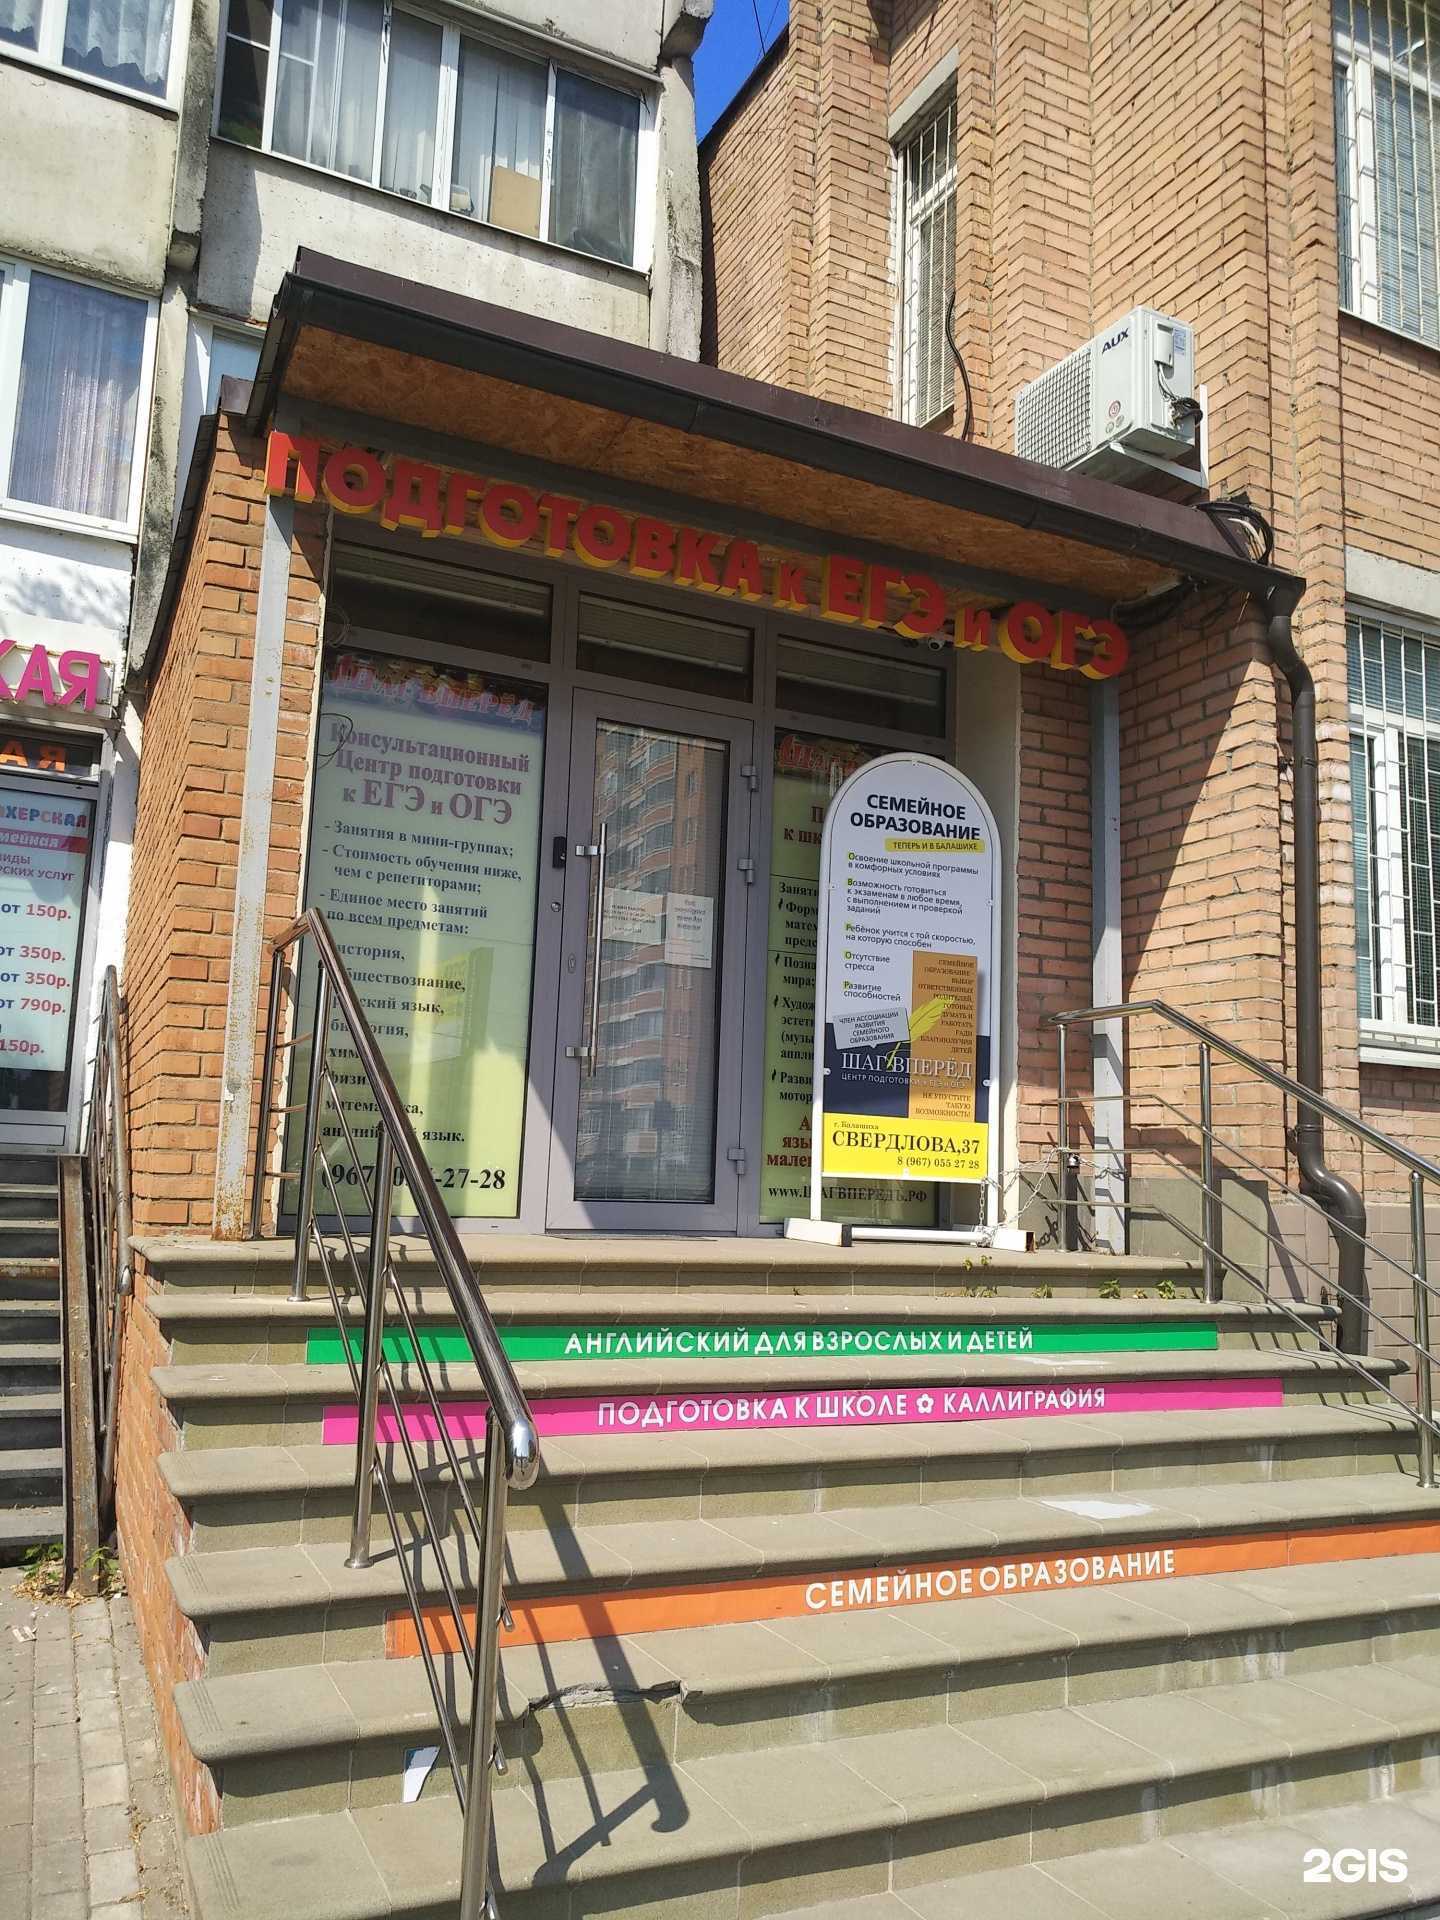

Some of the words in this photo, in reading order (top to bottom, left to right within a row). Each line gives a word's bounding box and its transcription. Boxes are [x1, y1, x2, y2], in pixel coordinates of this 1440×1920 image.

[1102, 327, 1129, 355] AUX
[264, 430, 763, 600] ПОДГОТОВКА
[820, 554, 946, 639] ЕГЭ
[1000, 602, 1129, 680] ОГЭ
[330, 723, 530, 772] Консультационный
[336, 749, 402, 780] Центр
[408, 764, 522, 795] подготовки
[361, 779, 425, 812] ЕГЭ
[431, 800, 443, 815] и
[450, 793, 512, 825] ОГЭ
[866, 794, 966, 820] СЕМЕЙНОЕ
[850, 812, 980, 840] ОБРАЗОВАНИЕ
[334, 820, 394, 840] Занятия
[399, 832, 407, 842] в
[411, 834, 514, 857] мини-группах;
[893, 841, 920, 850] ТЕПЕРЬ
[922, 842, 928, 850] И
[936, 842, 978, 850] БАЛАШИХЕ
[0, 853, 31, 864] ИДЫ
[332, 843, 412, 866] Стоимость
[415, 856, 479, 876] обучения
[484, 867, 522, 881] ниже,
[848, 852, 889, 864] Освоение
[890, 857, 930, 870] школьной
[933, 864, 979, 876] программы
[334, 866, 361, 879] чем
[366, 870, 373, 880] с
[376, 872, 481, 894] репетиторами;
[905, 868, 940, 879] условиях
[847, 878, 902, 892] Возможность
[904, 886, 947, 897] готовиться
[854, 888, 898, 900] экзаменам
[907, 895, 933, 904] любое
[26, 903, 71, 921] 150р.
[330, 888, 382, 907] Единое
[387, 896, 427, 912] место
[431, 901, 488, 918] занятий
[847, 904, 881, 915] заданий
[853, 898, 909, 909] выполнением
[918, 903, 963, 916] проверкой
[327, 909, 344, 922] по
[349, 913, 382, 926] всем
[387, 915, 469, 935] предметам:
[857, 935, 892, 946] которую
[894, 939, 932, 949] способен
[881, 929, 908, 939] учится
[916, 930, 930, 941] той
[20, 945, 66, 963] 350р.
[845, 951, 890, 963] Отсутствие
[844, 962, 875, 972] стресса
[25, 972, 70, 990] 350р.
[844, 981, 882, 992] Развитие
[844, 990, 901, 1001] способностей
[20, 998, 66, 1016] 790р.
[401, 1002, 444, 1014] язык,
[839, 1016, 856, 1024] ЧЛЕН
[856, 1011, 899, 1022] АССОЦИАЦИИ
[855, 1020, 886, 1029] РАЗВИТИЯ
[850, 1033, 894, 1043] ОБРАЗОВАНИЯ
[852, 1026, 890, 1037] СЕМЕЙНОГО
[841, 1052, 886, 1071] ШАГ
[841, 1072, 867, 1081] ЦЕНТР
[841, 1121, 879, 1130] Балашиха
[422, 1131, 465, 1143] язык.
[832, 1130, 980, 1154] СВЕРДЛОВА,37
[897, 1157, 902, 1165] 8
[906, 1157, 931, 1168] (967)
[934, 1159, 951, 1167] 055
[954, 1160, 965, 1169] 27
[968, 1161, 980, 1169] 28
[564, 1327, 749, 1354] АНГЛИЙСКИЙ
[754, 1331, 806, 1355] ДЛЯ
[812, 1330, 943, 1352] ВЗРОСЛЫХ
[949, 1331, 962, 1350] И
[967, 1327, 1033, 1352] ДЕТЕЙ
[598, 1398, 788, 1428] ПОДГОТОВКА
[796, 1396, 810, 1419] К
[816, 1393, 907, 1418] ШКОЛЕ
[943, 1387, 1105, 1415] КАЛЛИГРАФИЯ
[805, 1569, 972, 1610] СЕМЕЙНОЕ
[979, 1549, 1175, 1593] ОБРАЗОВАНИЕ
